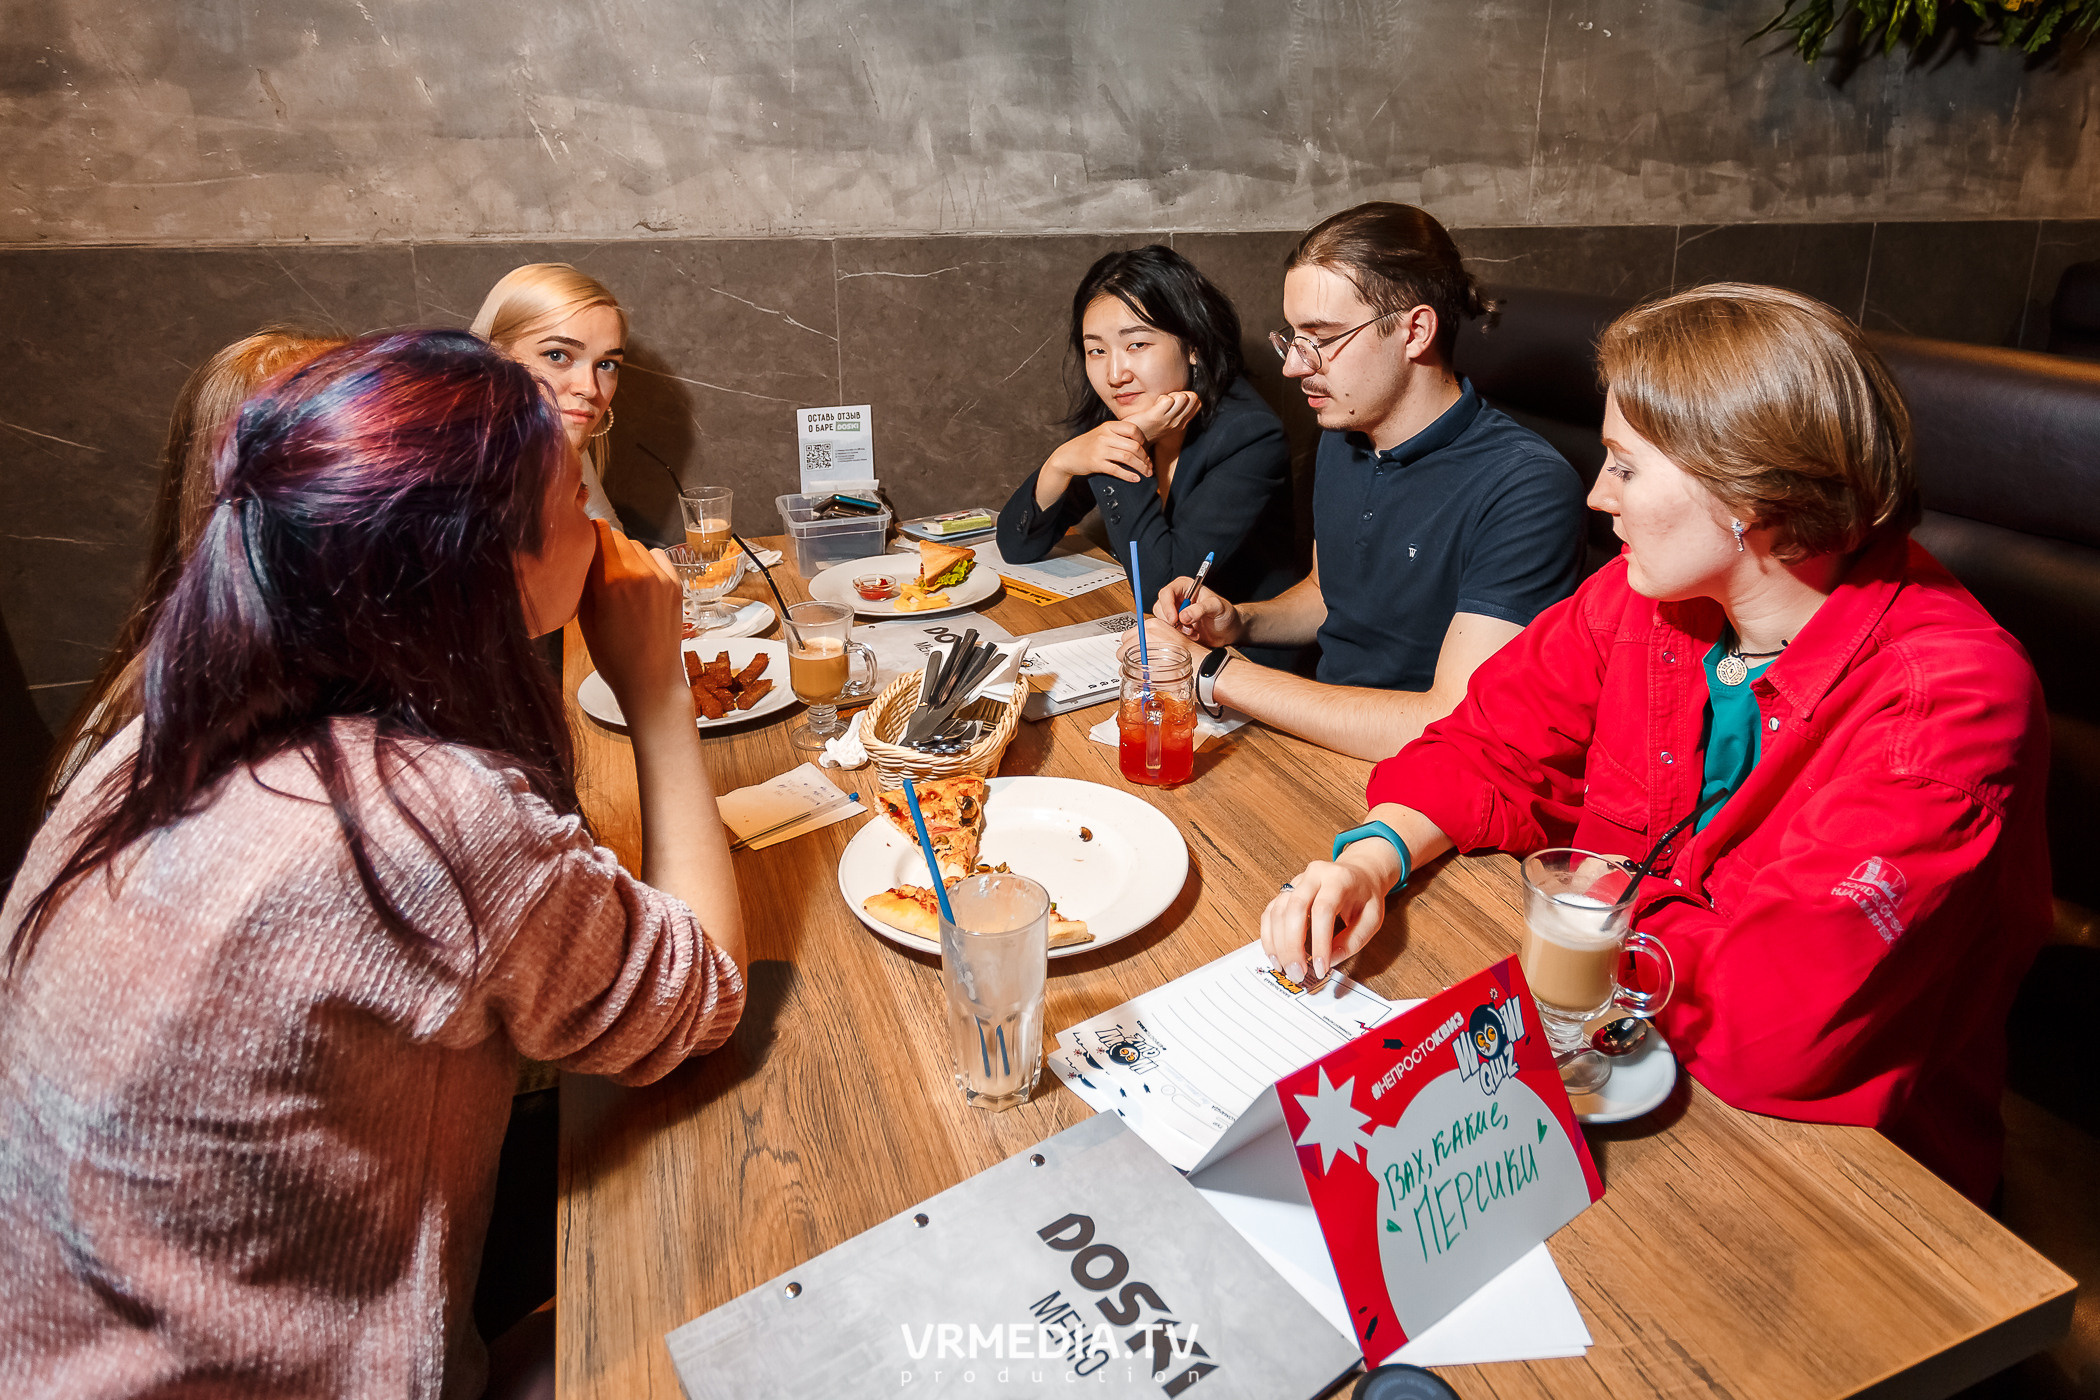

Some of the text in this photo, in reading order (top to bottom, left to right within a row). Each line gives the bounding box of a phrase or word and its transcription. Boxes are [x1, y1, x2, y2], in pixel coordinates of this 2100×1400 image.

[807, 411, 861, 423] ОСТАВЬ ОТЗЫВ
[808, 424, 814, 433] О
[815, 423, 834, 433] БАРЕ
[1371, 1011, 1465, 1101] #НЕПРОСТОКВИЗ
[1479, 1041, 1520, 1096] QUIZ
[1383, 1148, 1433, 1212] ВАХ,
[1413, 1143, 1540, 1264] ПЕРСИКИ
[1036, 1212, 1220, 1400] DOSKI
